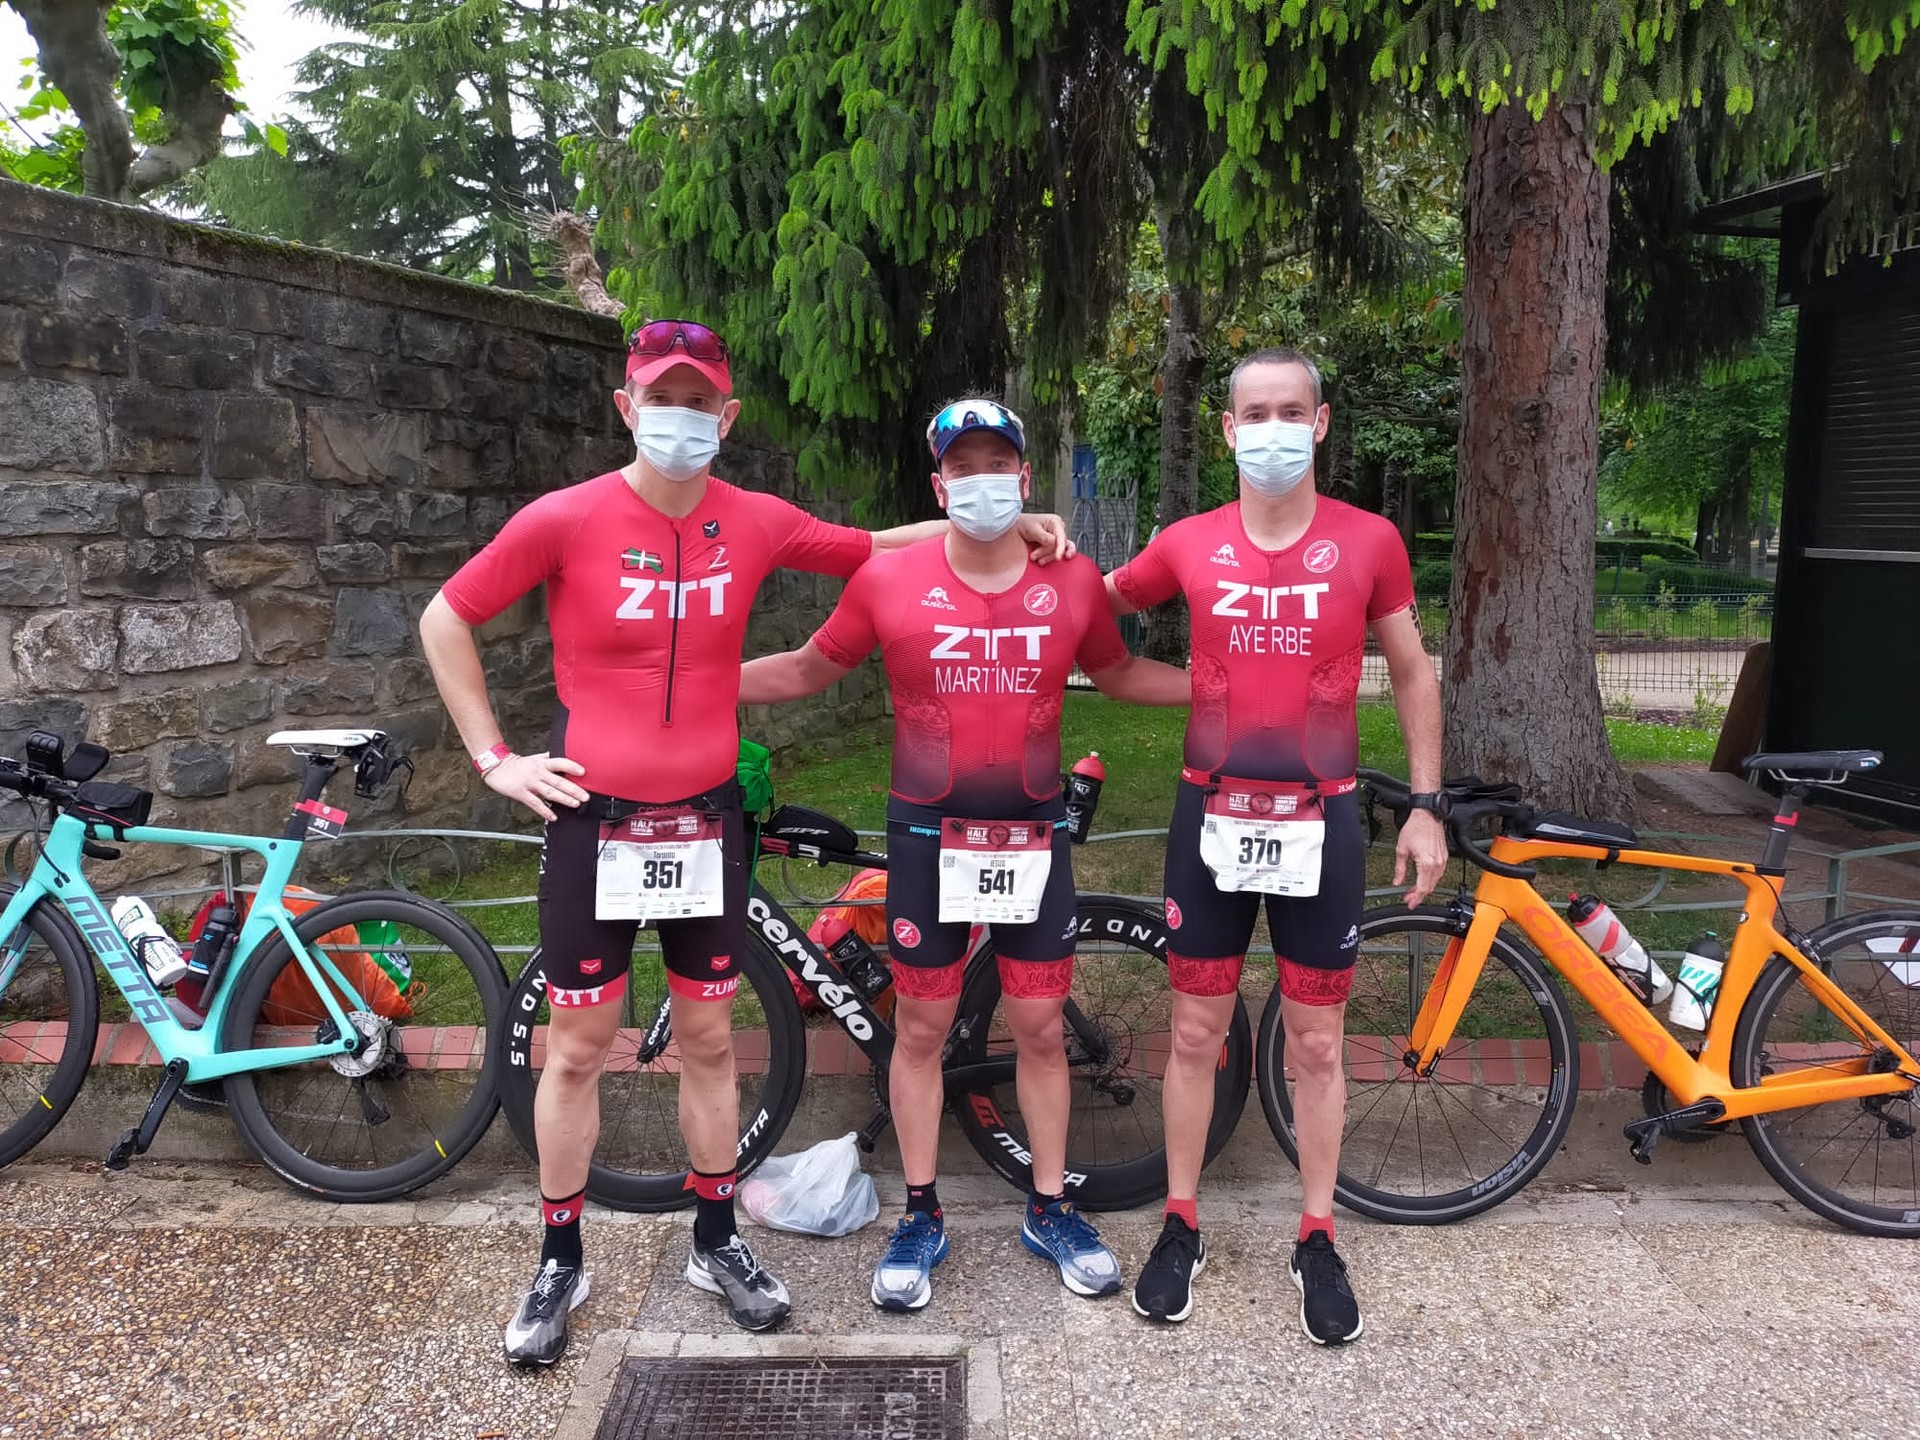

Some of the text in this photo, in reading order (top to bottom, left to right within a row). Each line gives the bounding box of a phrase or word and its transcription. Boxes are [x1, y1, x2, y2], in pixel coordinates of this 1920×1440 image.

[616, 572, 733, 619] ZTT
[1212, 580, 1330, 620] ZTT
[930, 624, 1052, 661] ZTT
[1238, 836, 1282, 866] 370
[642, 860, 684, 889] 351
[978, 868, 1015, 895] 541
[64, 896, 170, 1025] METTA
[747, 898, 874, 1042] cervélo
[552, 985, 604, 1006] ZTT
[1523, 906, 1669, 1064] ORBEA
[736, 1107, 769, 1158] ETTA
